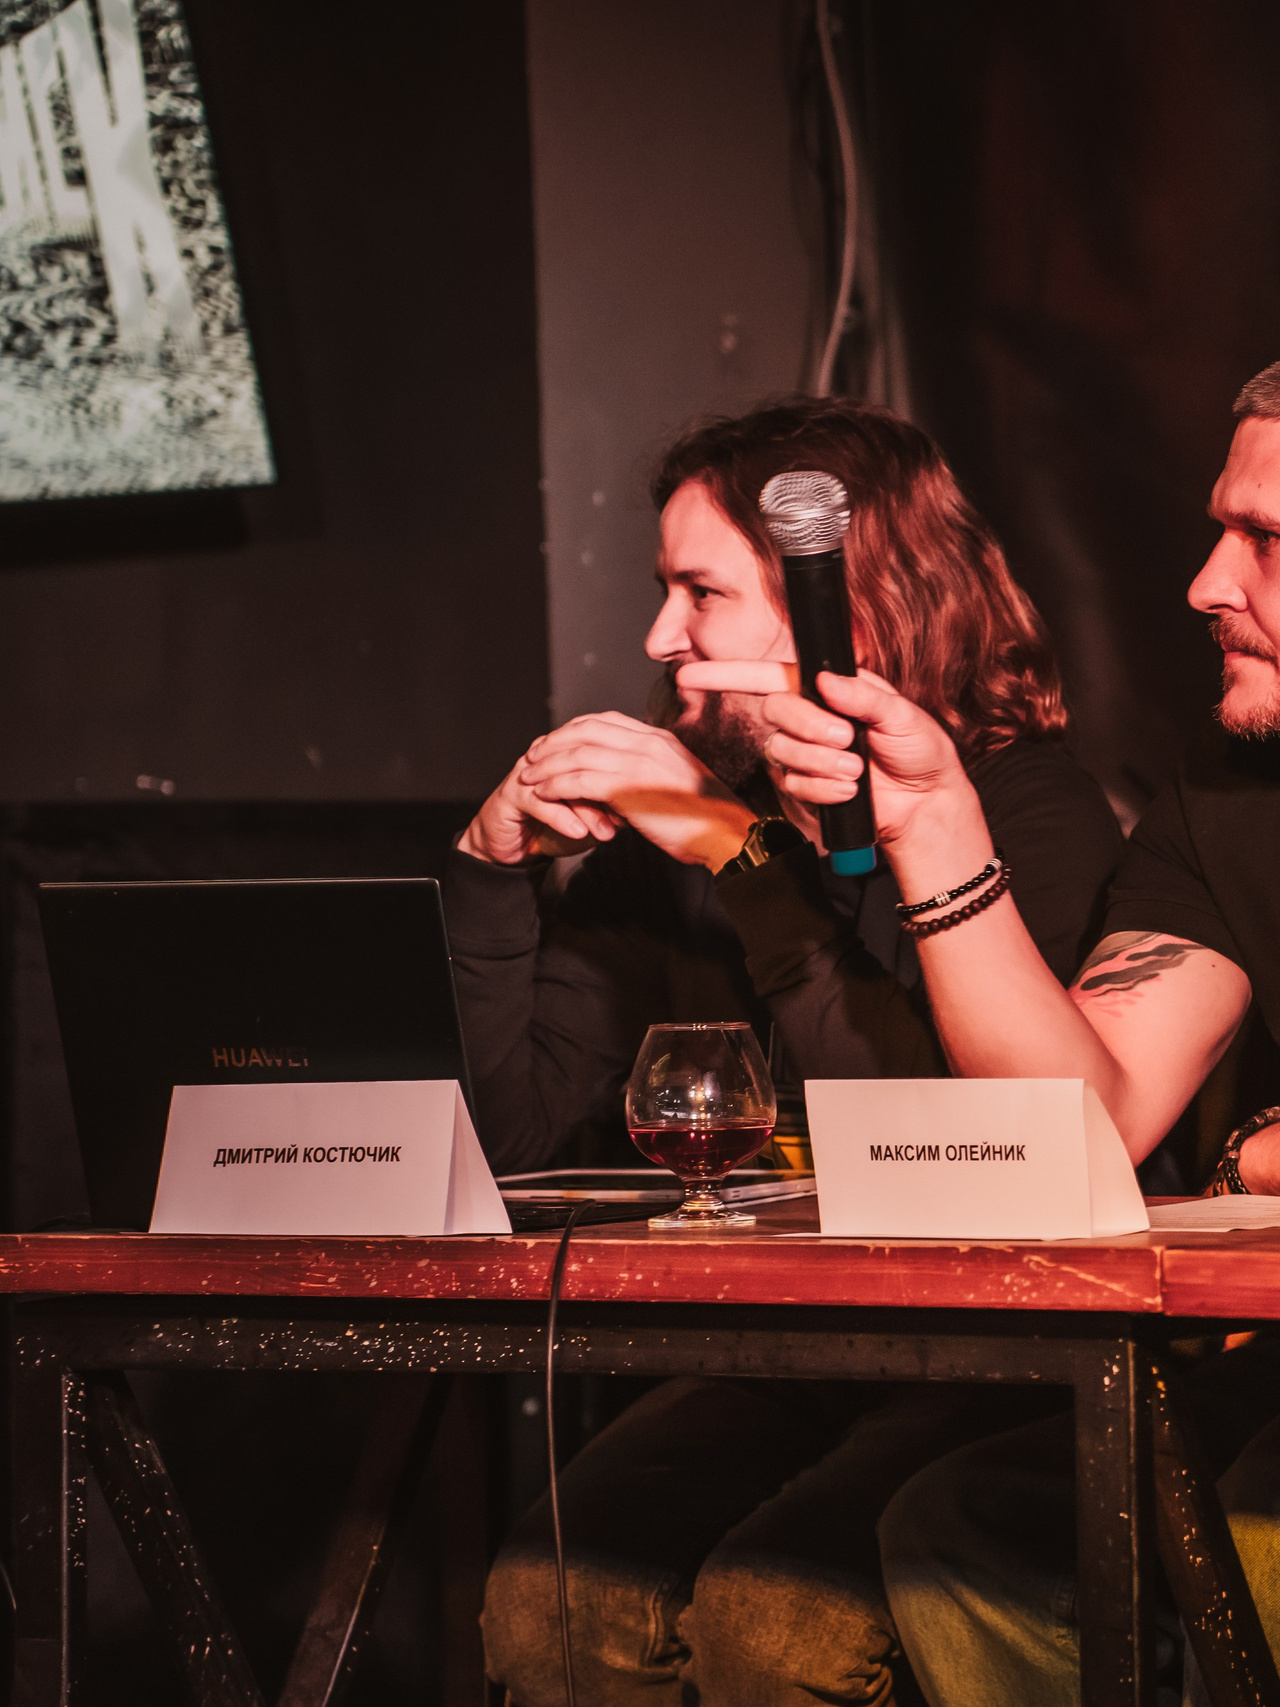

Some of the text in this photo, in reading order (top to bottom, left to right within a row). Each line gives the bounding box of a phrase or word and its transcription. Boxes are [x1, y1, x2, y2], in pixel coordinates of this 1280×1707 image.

[213, 1144, 402, 1168] ДМИТРИЙ КОСТЮЧИК
[869, 1141, 1026, 1162] МАКСИМ ОЛЕЙНИК
